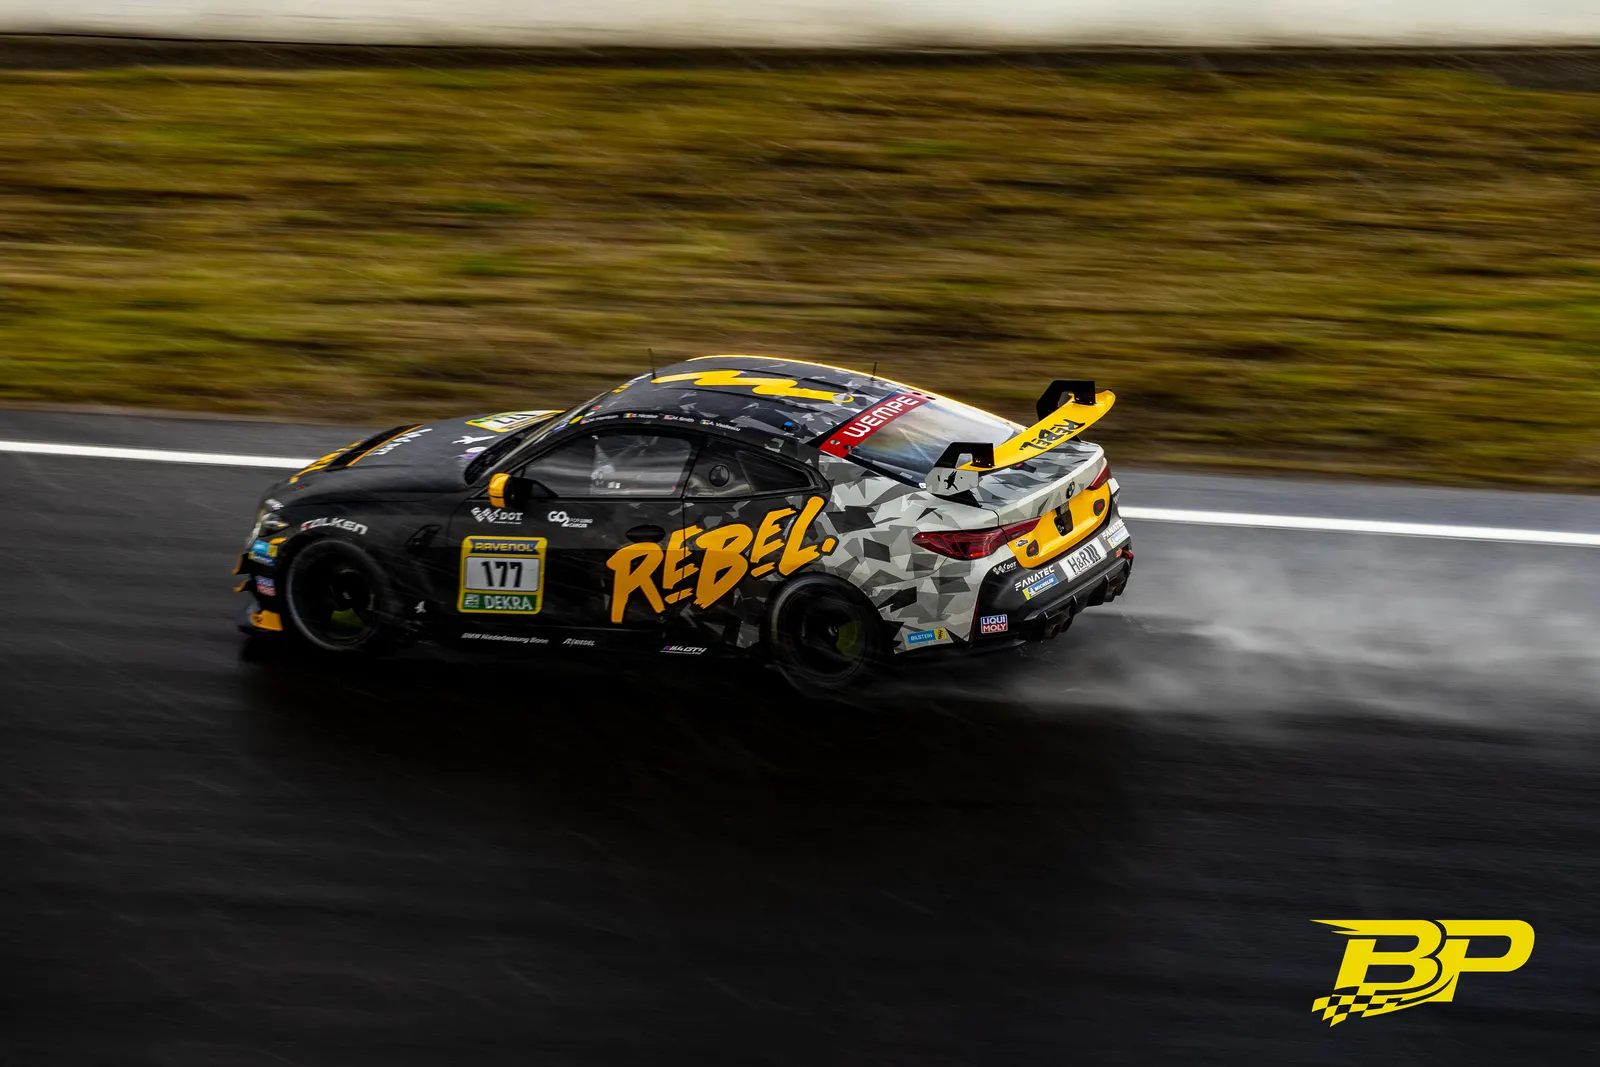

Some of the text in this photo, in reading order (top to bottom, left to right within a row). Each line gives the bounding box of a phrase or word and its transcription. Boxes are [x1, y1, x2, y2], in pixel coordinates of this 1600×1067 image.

[843, 395, 919, 438] WEMPE
[1019, 419, 1085, 450] REBEL
[499, 512, 524, 521] DOT
[300, 517, 368, 535] FALKEN
[474, 542, 534, 552] RAVENOL
[1006, 561, 1017, 570] DOT
[481, 561, 522, 588] 177
[1015, 565, 1055, 591] FANATEC
[484, 595, 533, 610] DEKRA
[982, 616, 1006, 625] LIQUI
[982, 624, 1007, 632] MOLY
